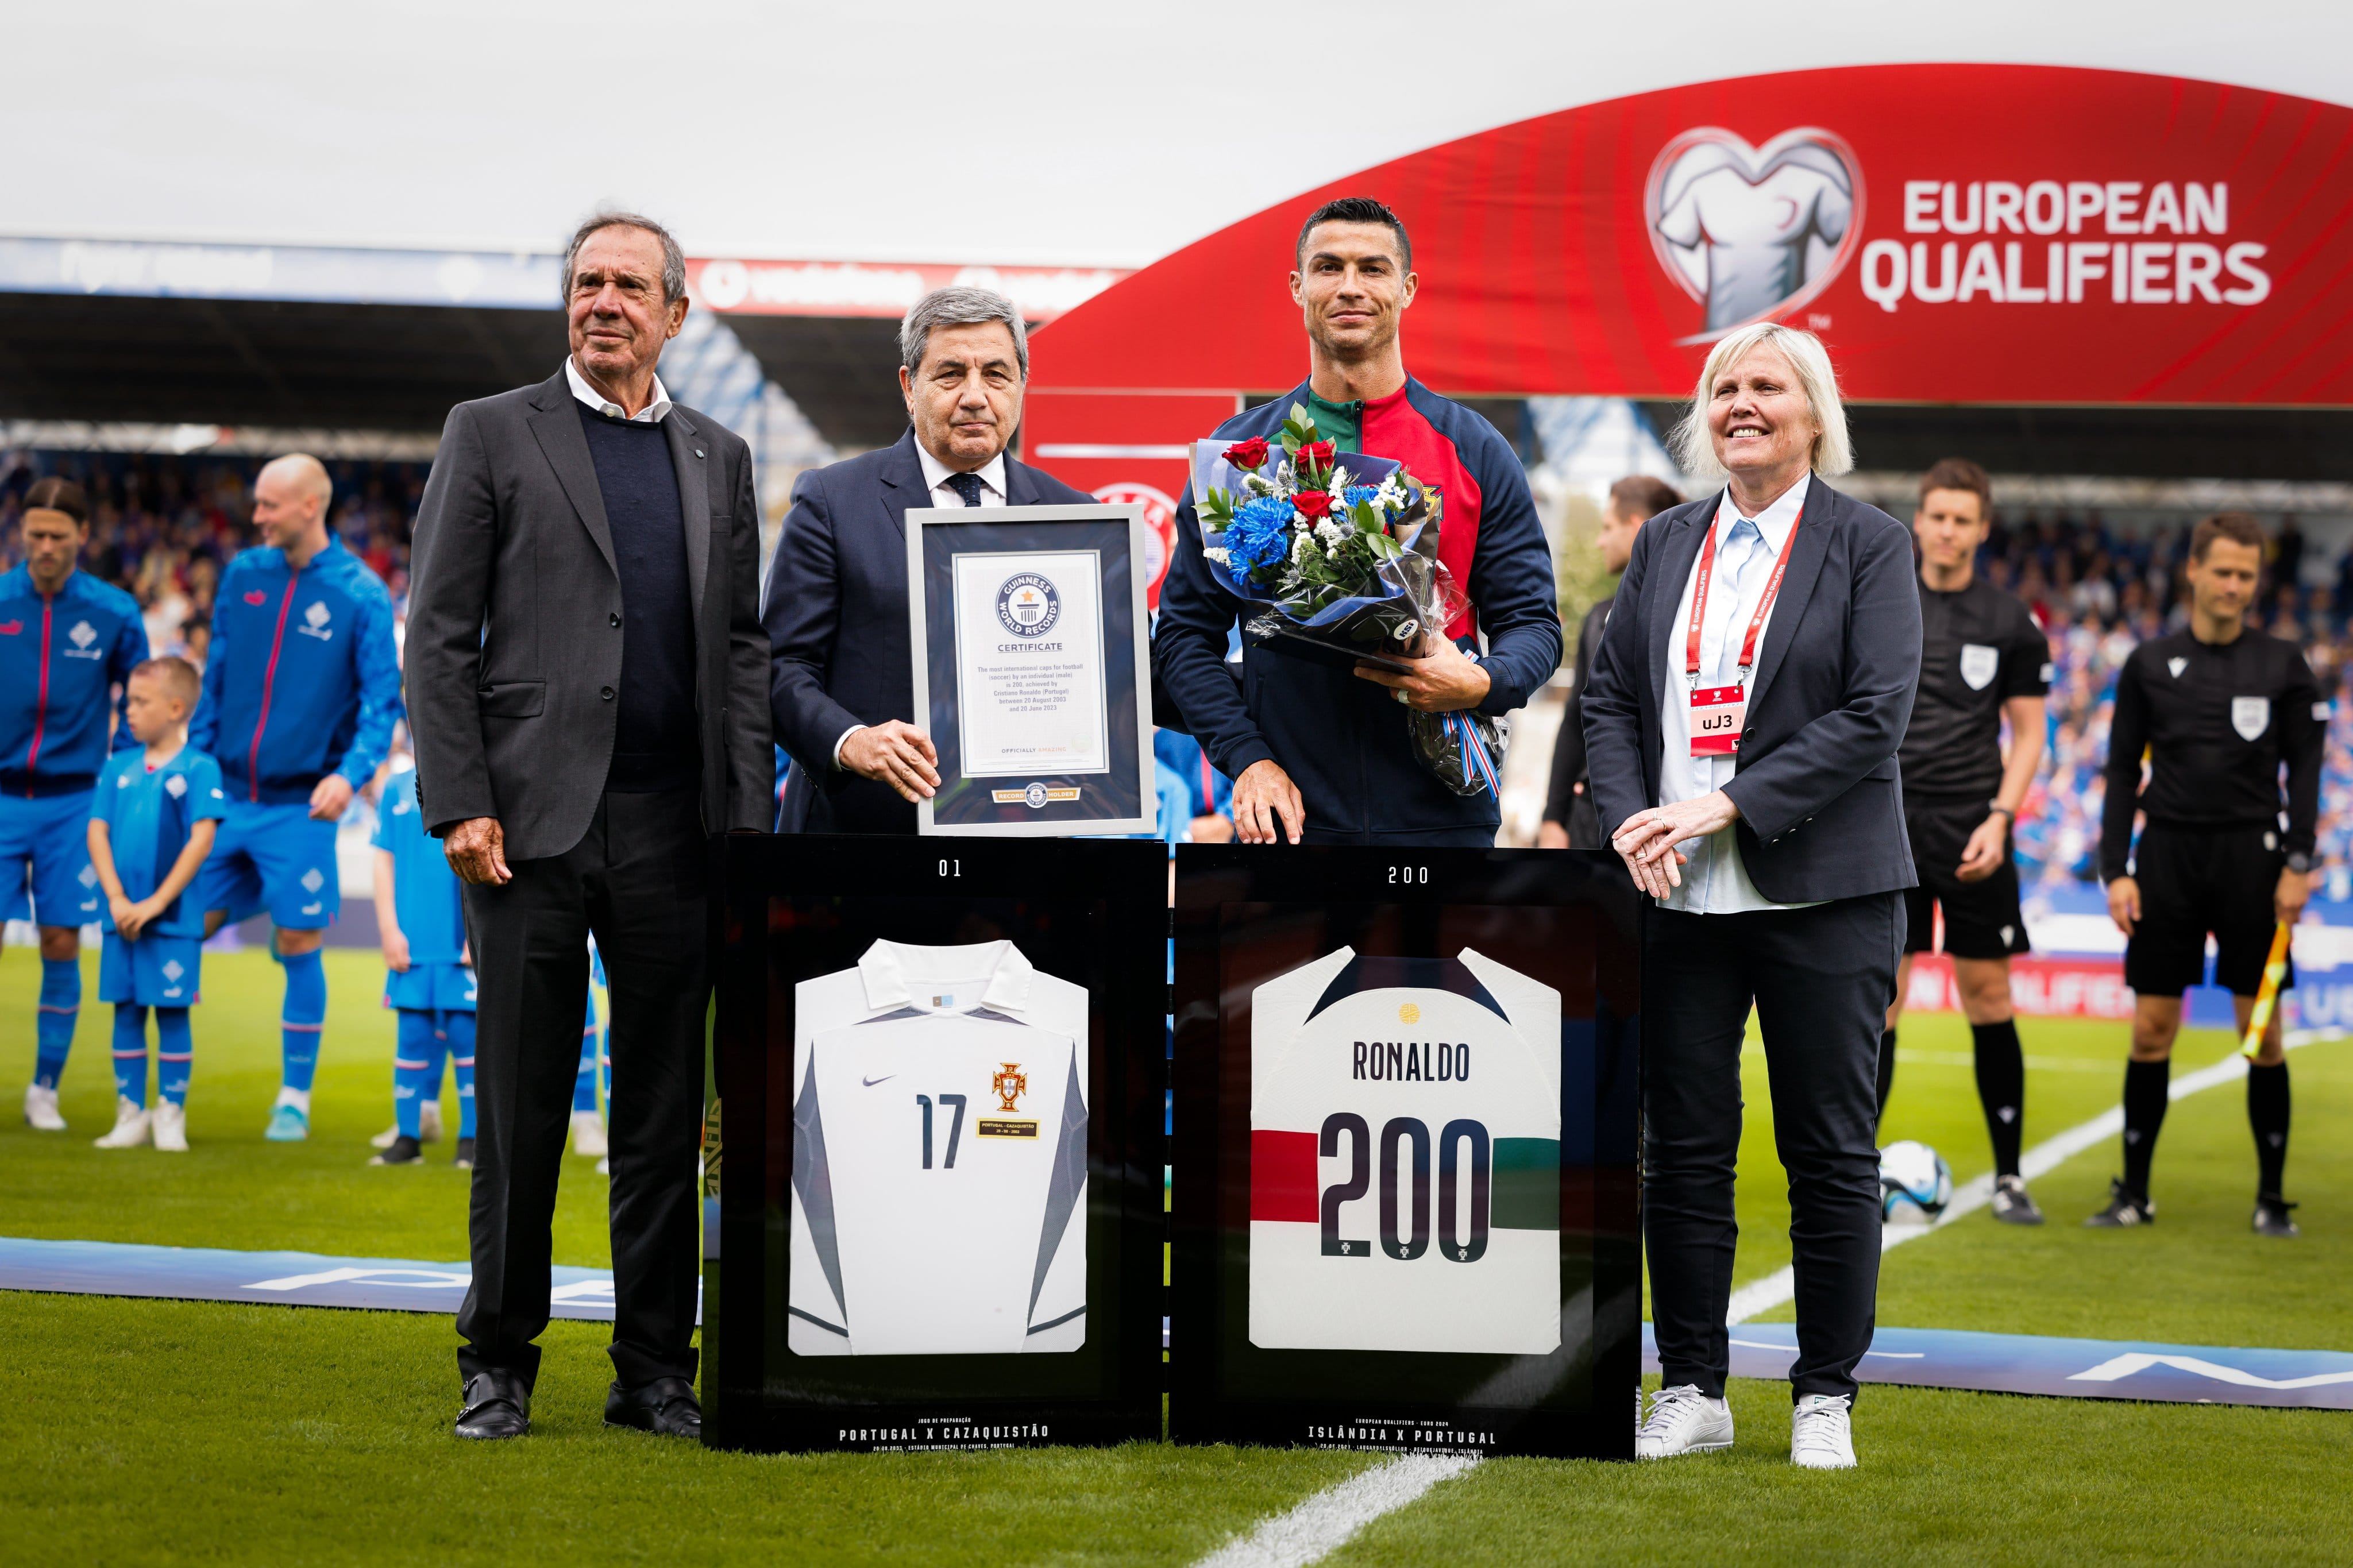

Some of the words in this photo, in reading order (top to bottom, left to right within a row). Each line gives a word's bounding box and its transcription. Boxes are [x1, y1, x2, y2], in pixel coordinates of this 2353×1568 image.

[1904, 180, 2227, 233] EUROPEAN
[1860, 240, 2271, 311] QUALIFIERS
[1004, 577, 1051, 594] GUINNESS
[1698, 569, 1707, 597] QUALIFIERS
[1757, 590, 1773, 617] EUROPEAN
[1769, 565, 1785, 591] QUALIFIERS
[1000, 602, 1022, 632] WORLD
[1025, 600, 1057, 635] RECORDS
[1694, 597, 1703, 623] EUROPEAN
[998, 643, 1063, 652] CERTIFICATE
[1703, 715, 1733, 729] uJ3
[1388, 866, 1429, 885] 200
[1352, 1041, 1469, 1082] RONALDO
[916, 1094, 967, 1170] 17
[1319, 1112, 1490, 1263] 200
[839, 1427, 917, 1441] PORTUGAL
[927, 1428, 934, 1439] X
[943, 1423, 1048, 1440] CAZAQUISTÃO
[1308, 1425, 1386, 1440] ISLÂNDIA
[1397, 1430, 1404, 1440] X
[1415, 1430, 1496, 1445] PORTUGAL
